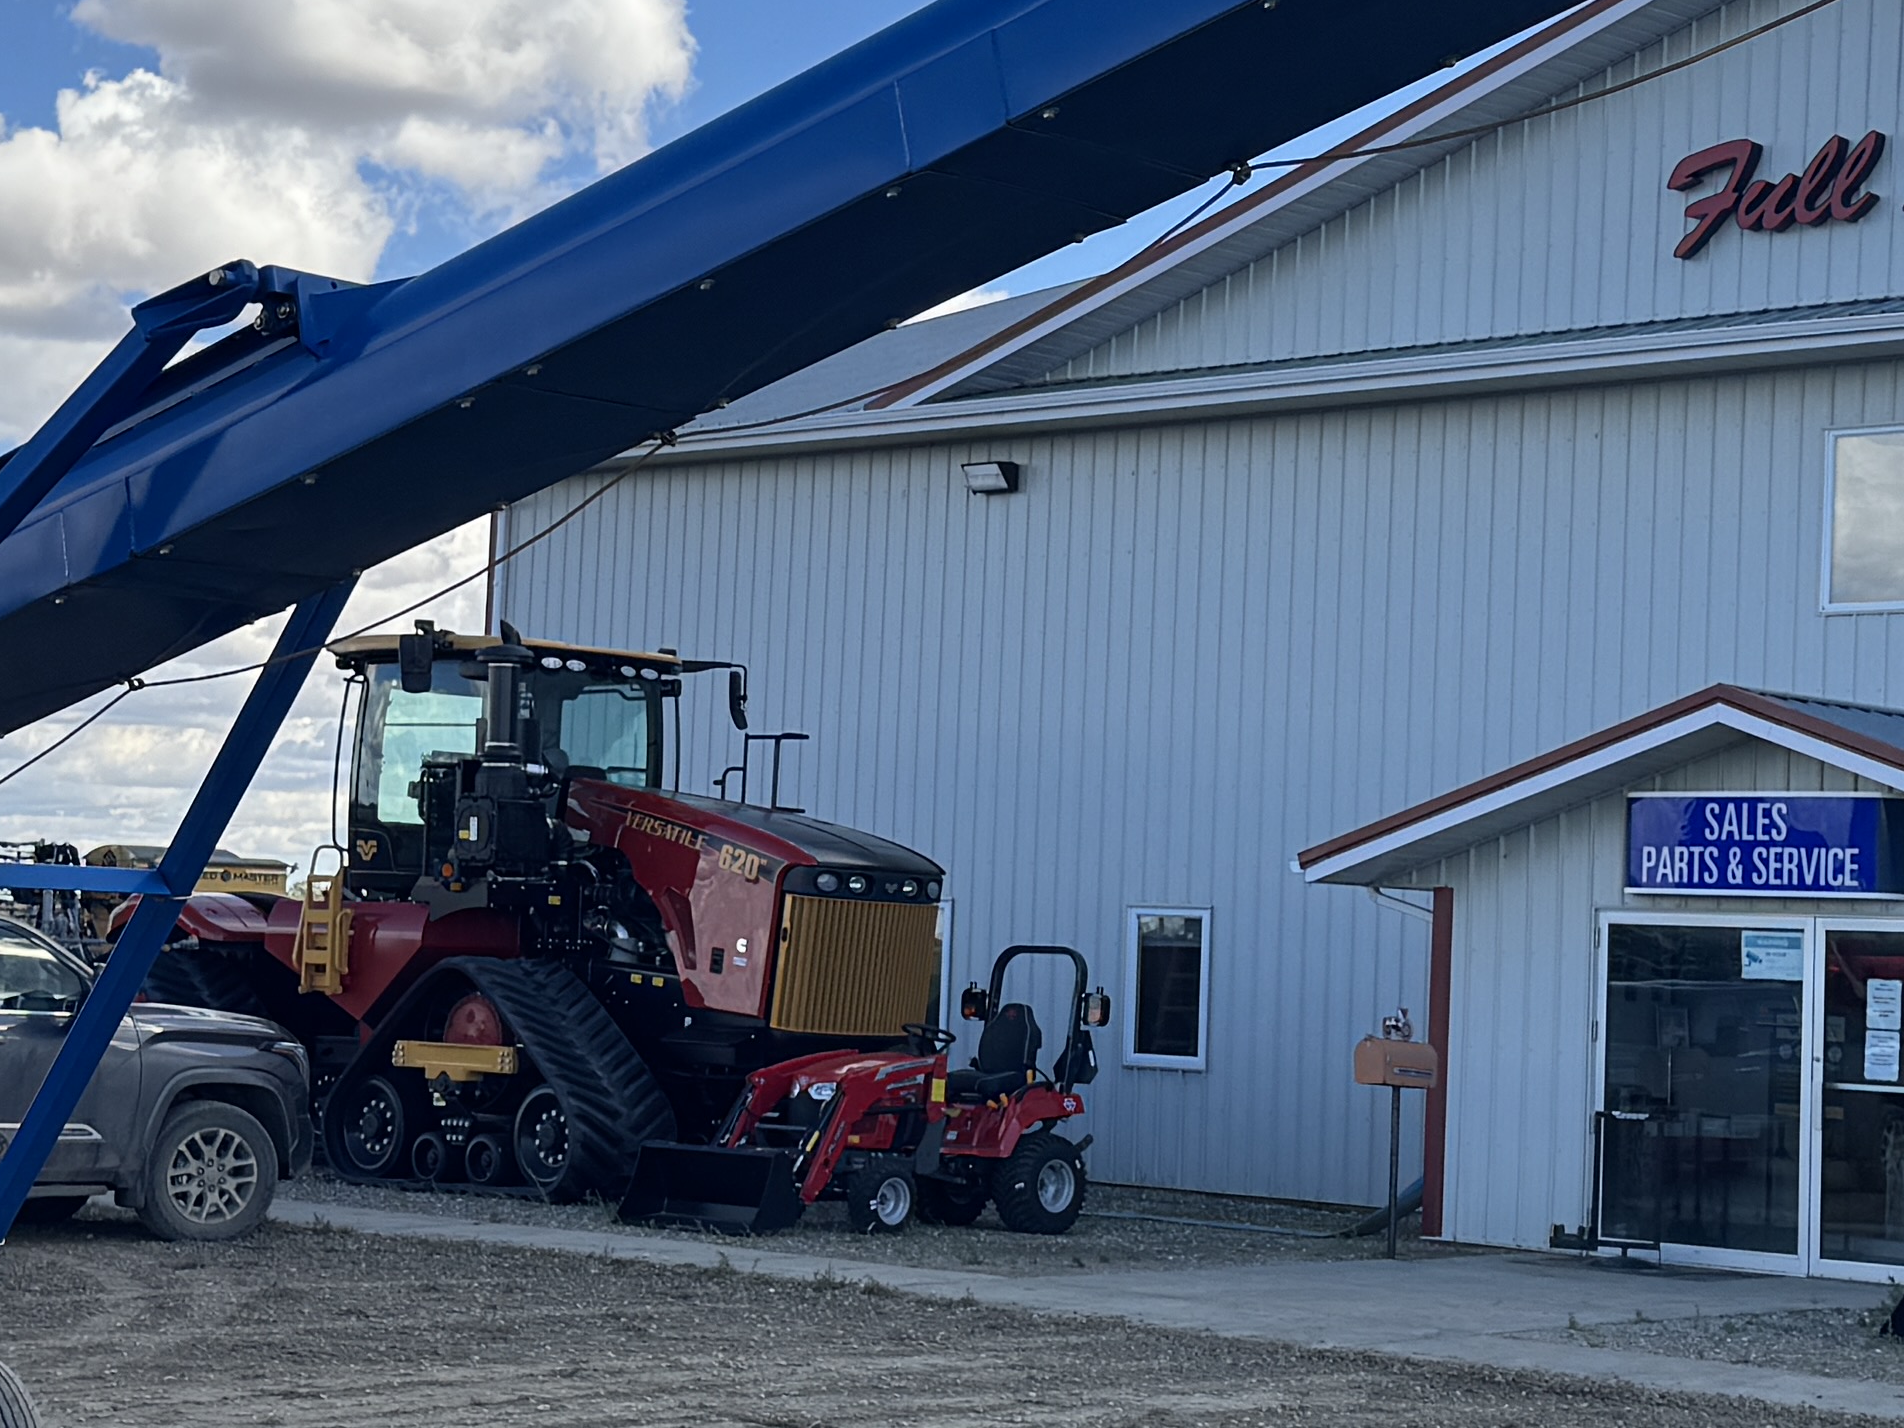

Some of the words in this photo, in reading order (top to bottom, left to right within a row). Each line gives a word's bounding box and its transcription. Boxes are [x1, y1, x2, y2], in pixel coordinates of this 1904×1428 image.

[1666, 129, 1887, 261] Full
[625, 810, 710, 852] VERSATILE
[1703, 801, 1789, 842] SALES
[232, 873, 279, 884] MASTER
[1641, 845, 1720, 885] PARTS
[1726, 846, 1744, 885] &
[1751, 846, 1860, 888] SERVICE
